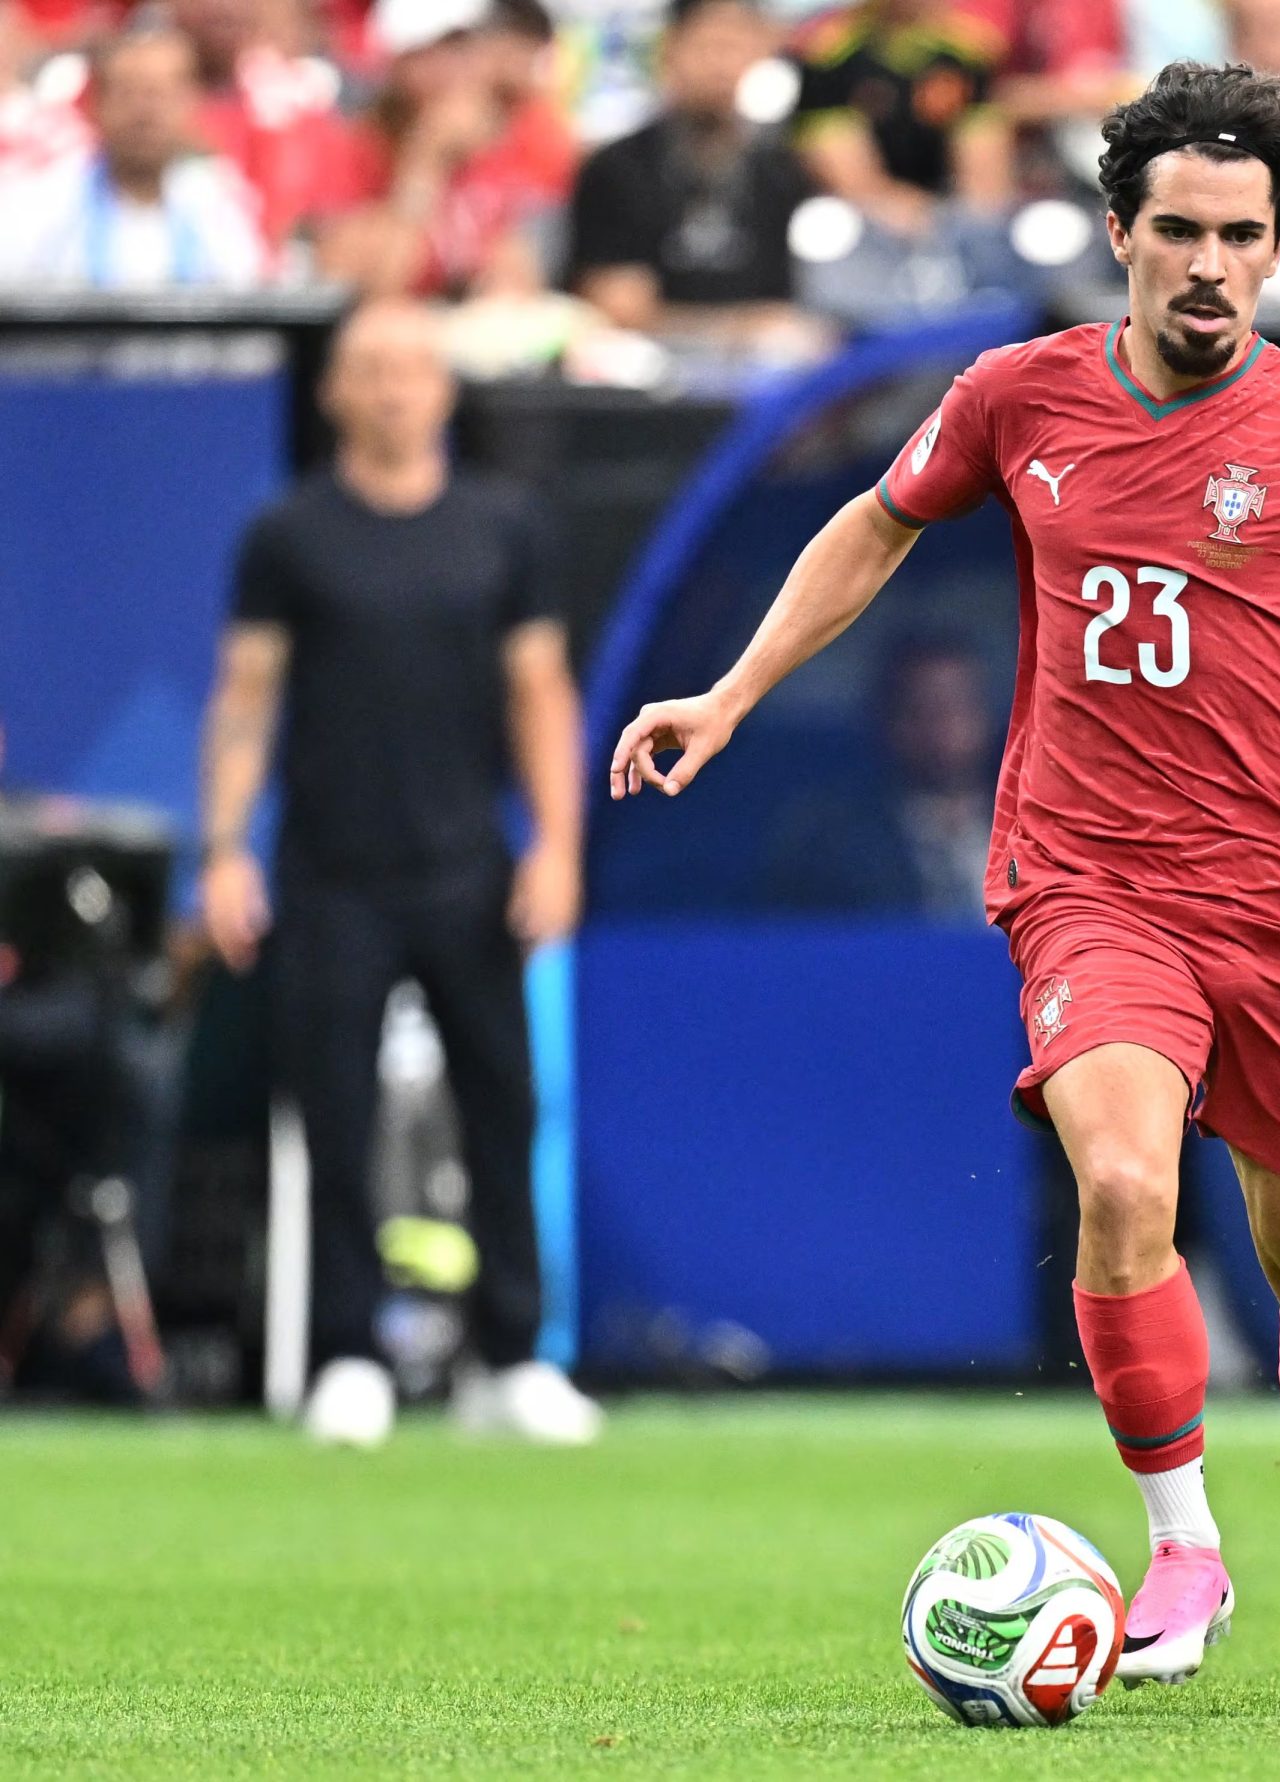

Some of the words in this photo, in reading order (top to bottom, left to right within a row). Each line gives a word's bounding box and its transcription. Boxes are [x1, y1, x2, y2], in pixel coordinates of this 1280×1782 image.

[1206, 558, 1242, 569] HOUSTON
[1081, 565, 1191, 688] 23
[934, 1630, 995, 1662] TRIONDA
